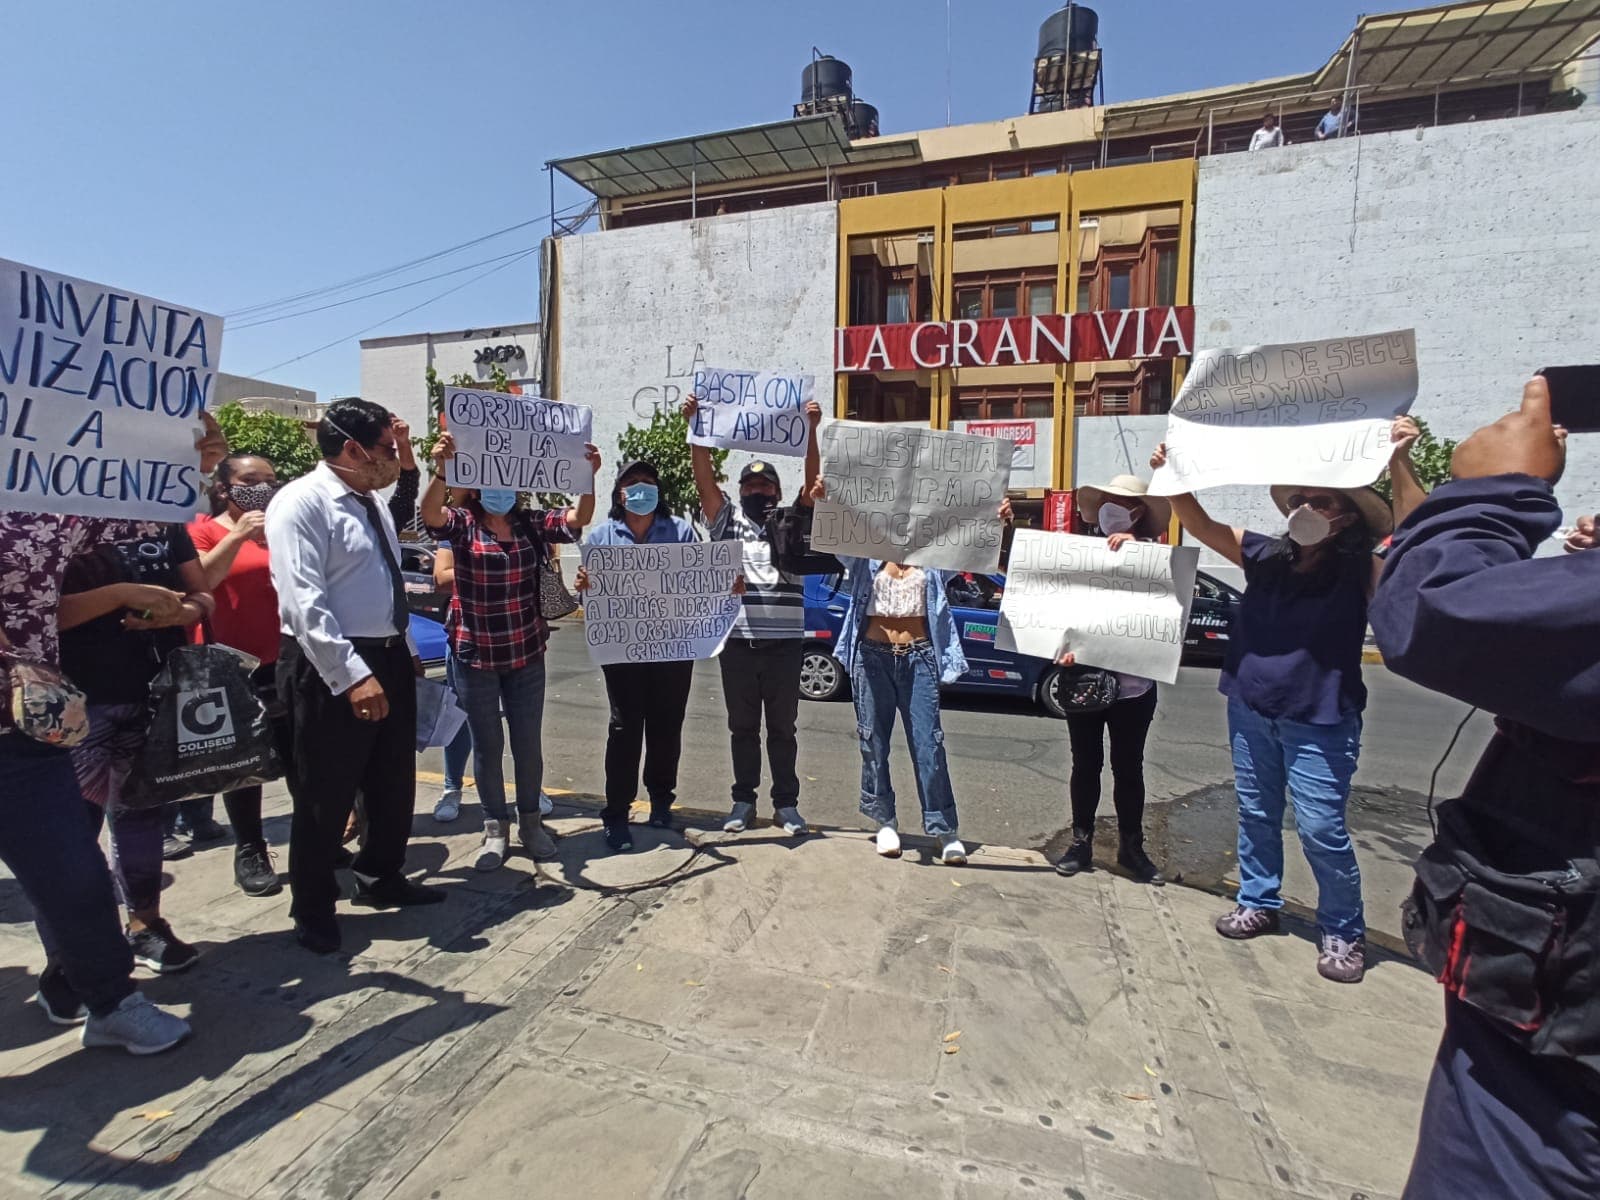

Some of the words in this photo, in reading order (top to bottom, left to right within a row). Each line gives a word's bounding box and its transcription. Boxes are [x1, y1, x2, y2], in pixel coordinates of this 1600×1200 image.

[19, 270, 208, 368] INVENTA
[835, 325, 895, 372] LA
[909, 313, 1073, 369] GRAN
[1093, 305, 1193, 362] VIA
[664, 343, 708, 378] LA
[1282, 346, 1320, 379] DE
[694, 371, 757, 407] BASTA
[764, 377, 803, 412] CON
[1228, 371, 1344, 413] EDWIN
[0, 391, 38, 441] L
[67, 410, 103, 448] A
[450, 393, 582, 435] CORRUPCION
[694, 406, 724, 438] EL
[732, 412, 806, 447] ABUSO
[486, 429, 512, 454] DE
[529, 432, 558, 458] LA
[823, 425, 997, 472] JUSTICIA
[6, 448, 198, 508] INOCENTES
[454, 451, 572, 490] DIVIAC
[823, 475, 895, 505] PARA
[813, 510, 1001, 548] INOCENTES
[681, 544, 704, 568] DE
[710, 543, 731, 566] LA
[660, 566, 743, 595] INCRIMINA
[586, 599, 602, 621] A
[674, 594, 740, 618] INOCENTES
[1188, 616, 1229, 628] nline
[587, 620, 630, 647] COMO
[965, 623, 998, 634] FORMA
[625, 641, 697, 662] CRIMINAL
[178, 735, 236, 753] COLISEUM
